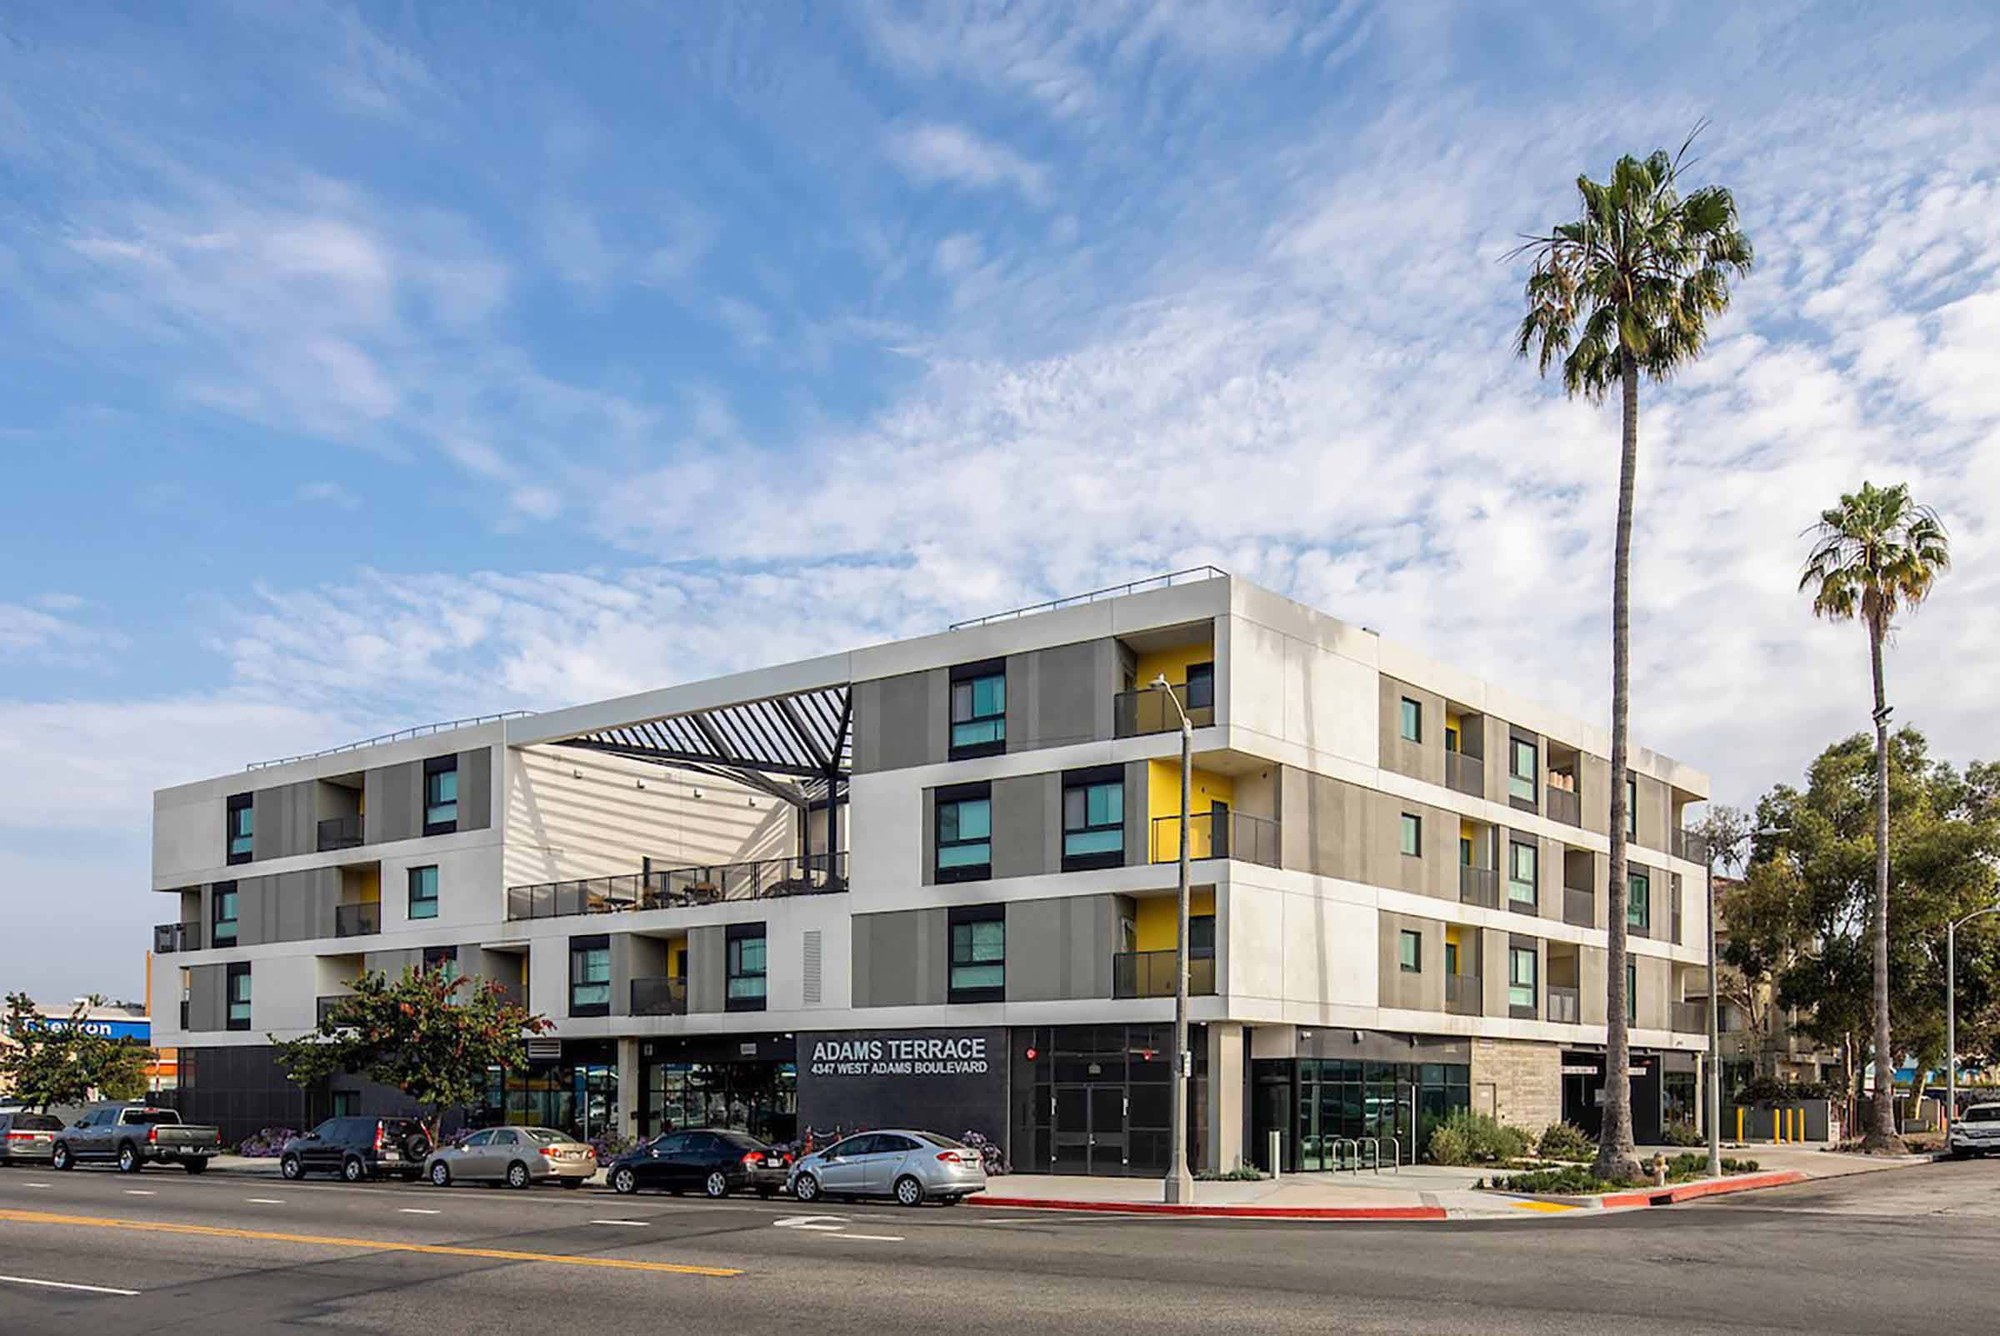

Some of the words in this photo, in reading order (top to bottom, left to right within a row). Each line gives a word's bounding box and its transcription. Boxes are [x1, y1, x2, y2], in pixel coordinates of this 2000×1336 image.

[812, 1041, 882, 1061] ADAMS
[887, 1038, 986, 1060] TERRACE
[811, 1063, 835, 1075] 4347
[837, 1063, 869, 1074] WEST
[871, 1062, 912, 1074] ADAMS
[915, 1061, 988, 1074] BOULEVARD
